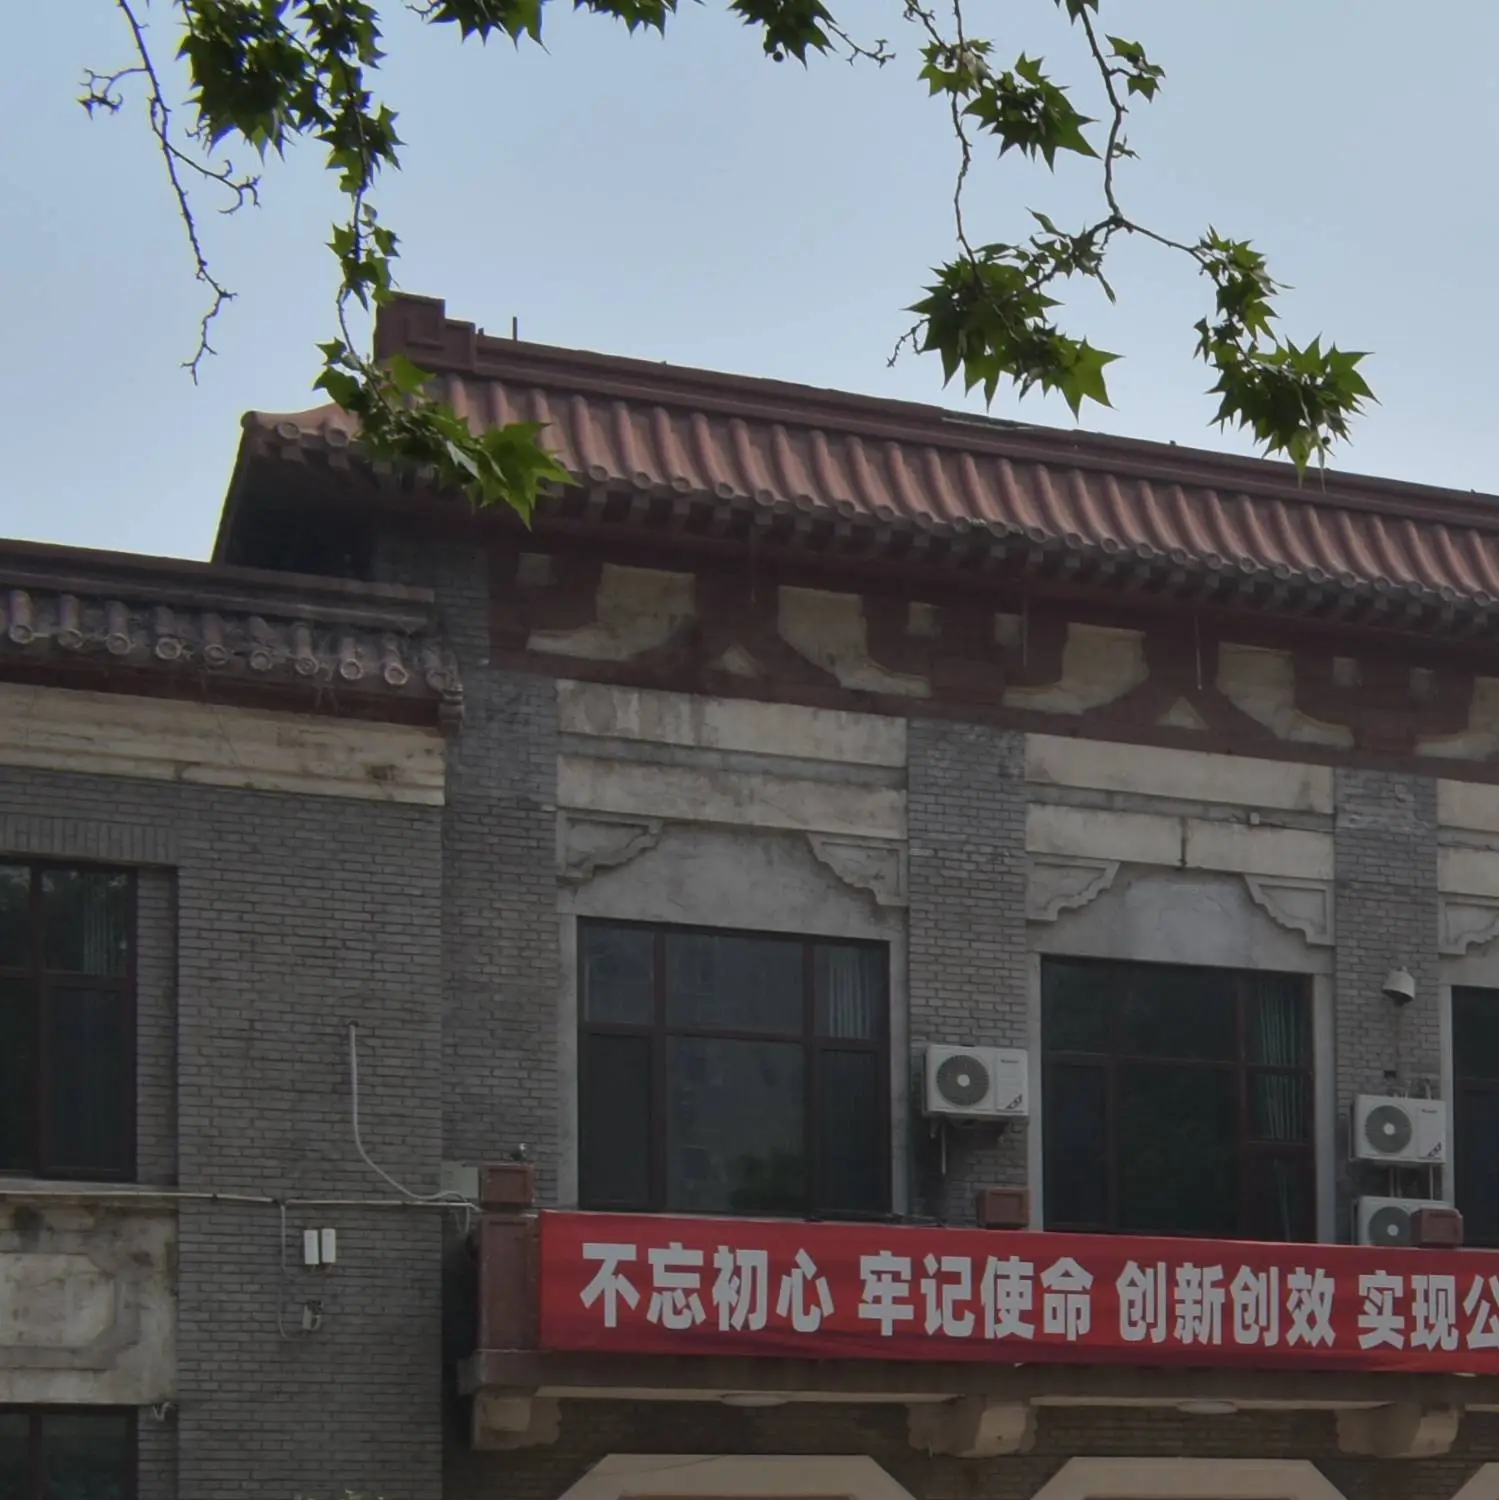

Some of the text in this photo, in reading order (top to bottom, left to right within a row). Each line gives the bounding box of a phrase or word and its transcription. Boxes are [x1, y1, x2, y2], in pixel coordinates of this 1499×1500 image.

[579, 1242, 834, 1333] 不忘初心
[858, 1250, 1094, 1341] 牢记使命
[1115, 1261, 1336, 1347] 创新创效
